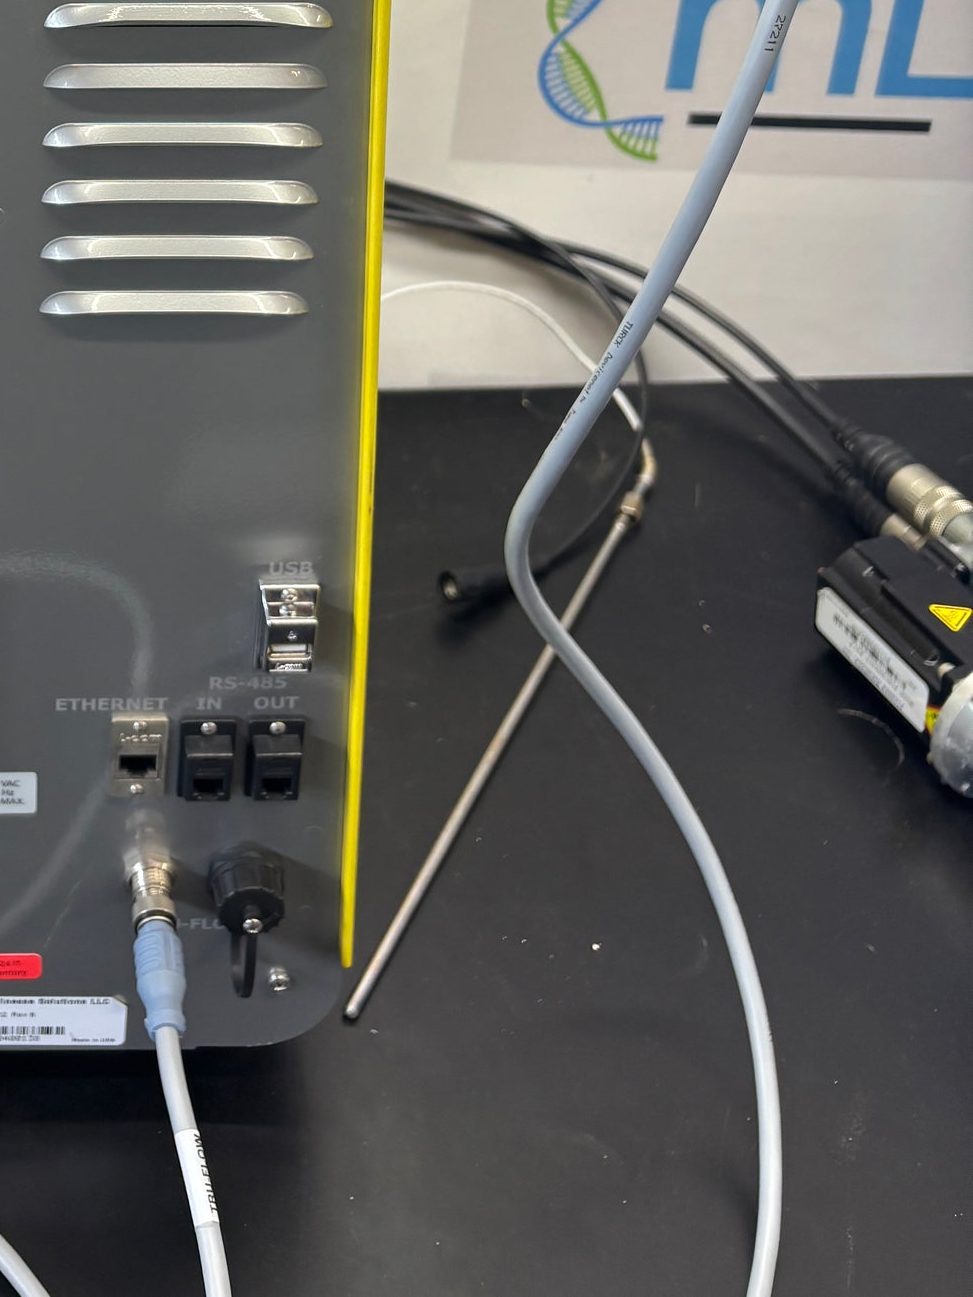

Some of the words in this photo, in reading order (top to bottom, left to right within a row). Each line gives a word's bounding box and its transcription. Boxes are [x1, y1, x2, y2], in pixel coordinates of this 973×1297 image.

[764, 15, 786, 52] 27211
[613, 321, 633, 348] TURCK
[268, 561, 314, 577] USB
[209, 676, 288, 690] RS-485
[55, 698, 169, 711] ETHERNET
[196, 697, 222, 710] IN
[253, 696, 300, 710] OUT
